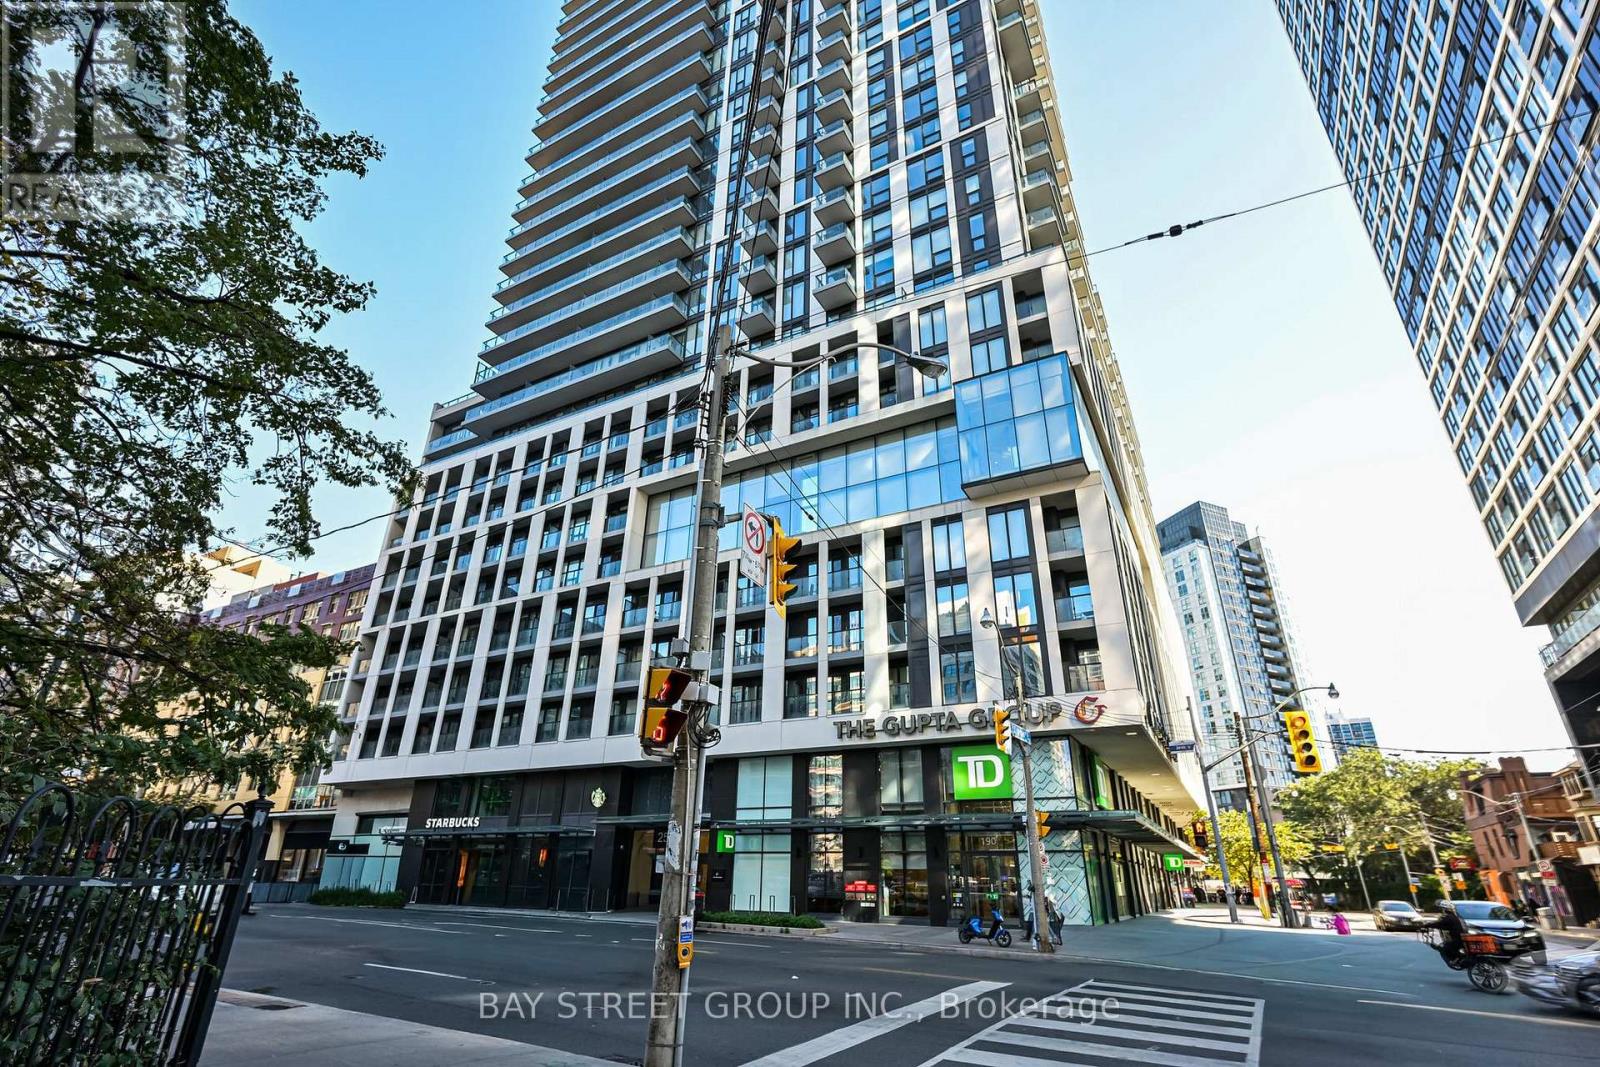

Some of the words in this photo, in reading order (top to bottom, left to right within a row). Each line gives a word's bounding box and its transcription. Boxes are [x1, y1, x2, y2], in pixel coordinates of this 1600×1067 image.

[833, 718, 876, 739] THE
[882, 711, 962, 737] GUPTA
[957, 754, 1004, 788] TD
[425, 816, 480, 829] STARBUCKS
[723, 834, 735, 849] TD
[981, 836, 997, 846] 190
